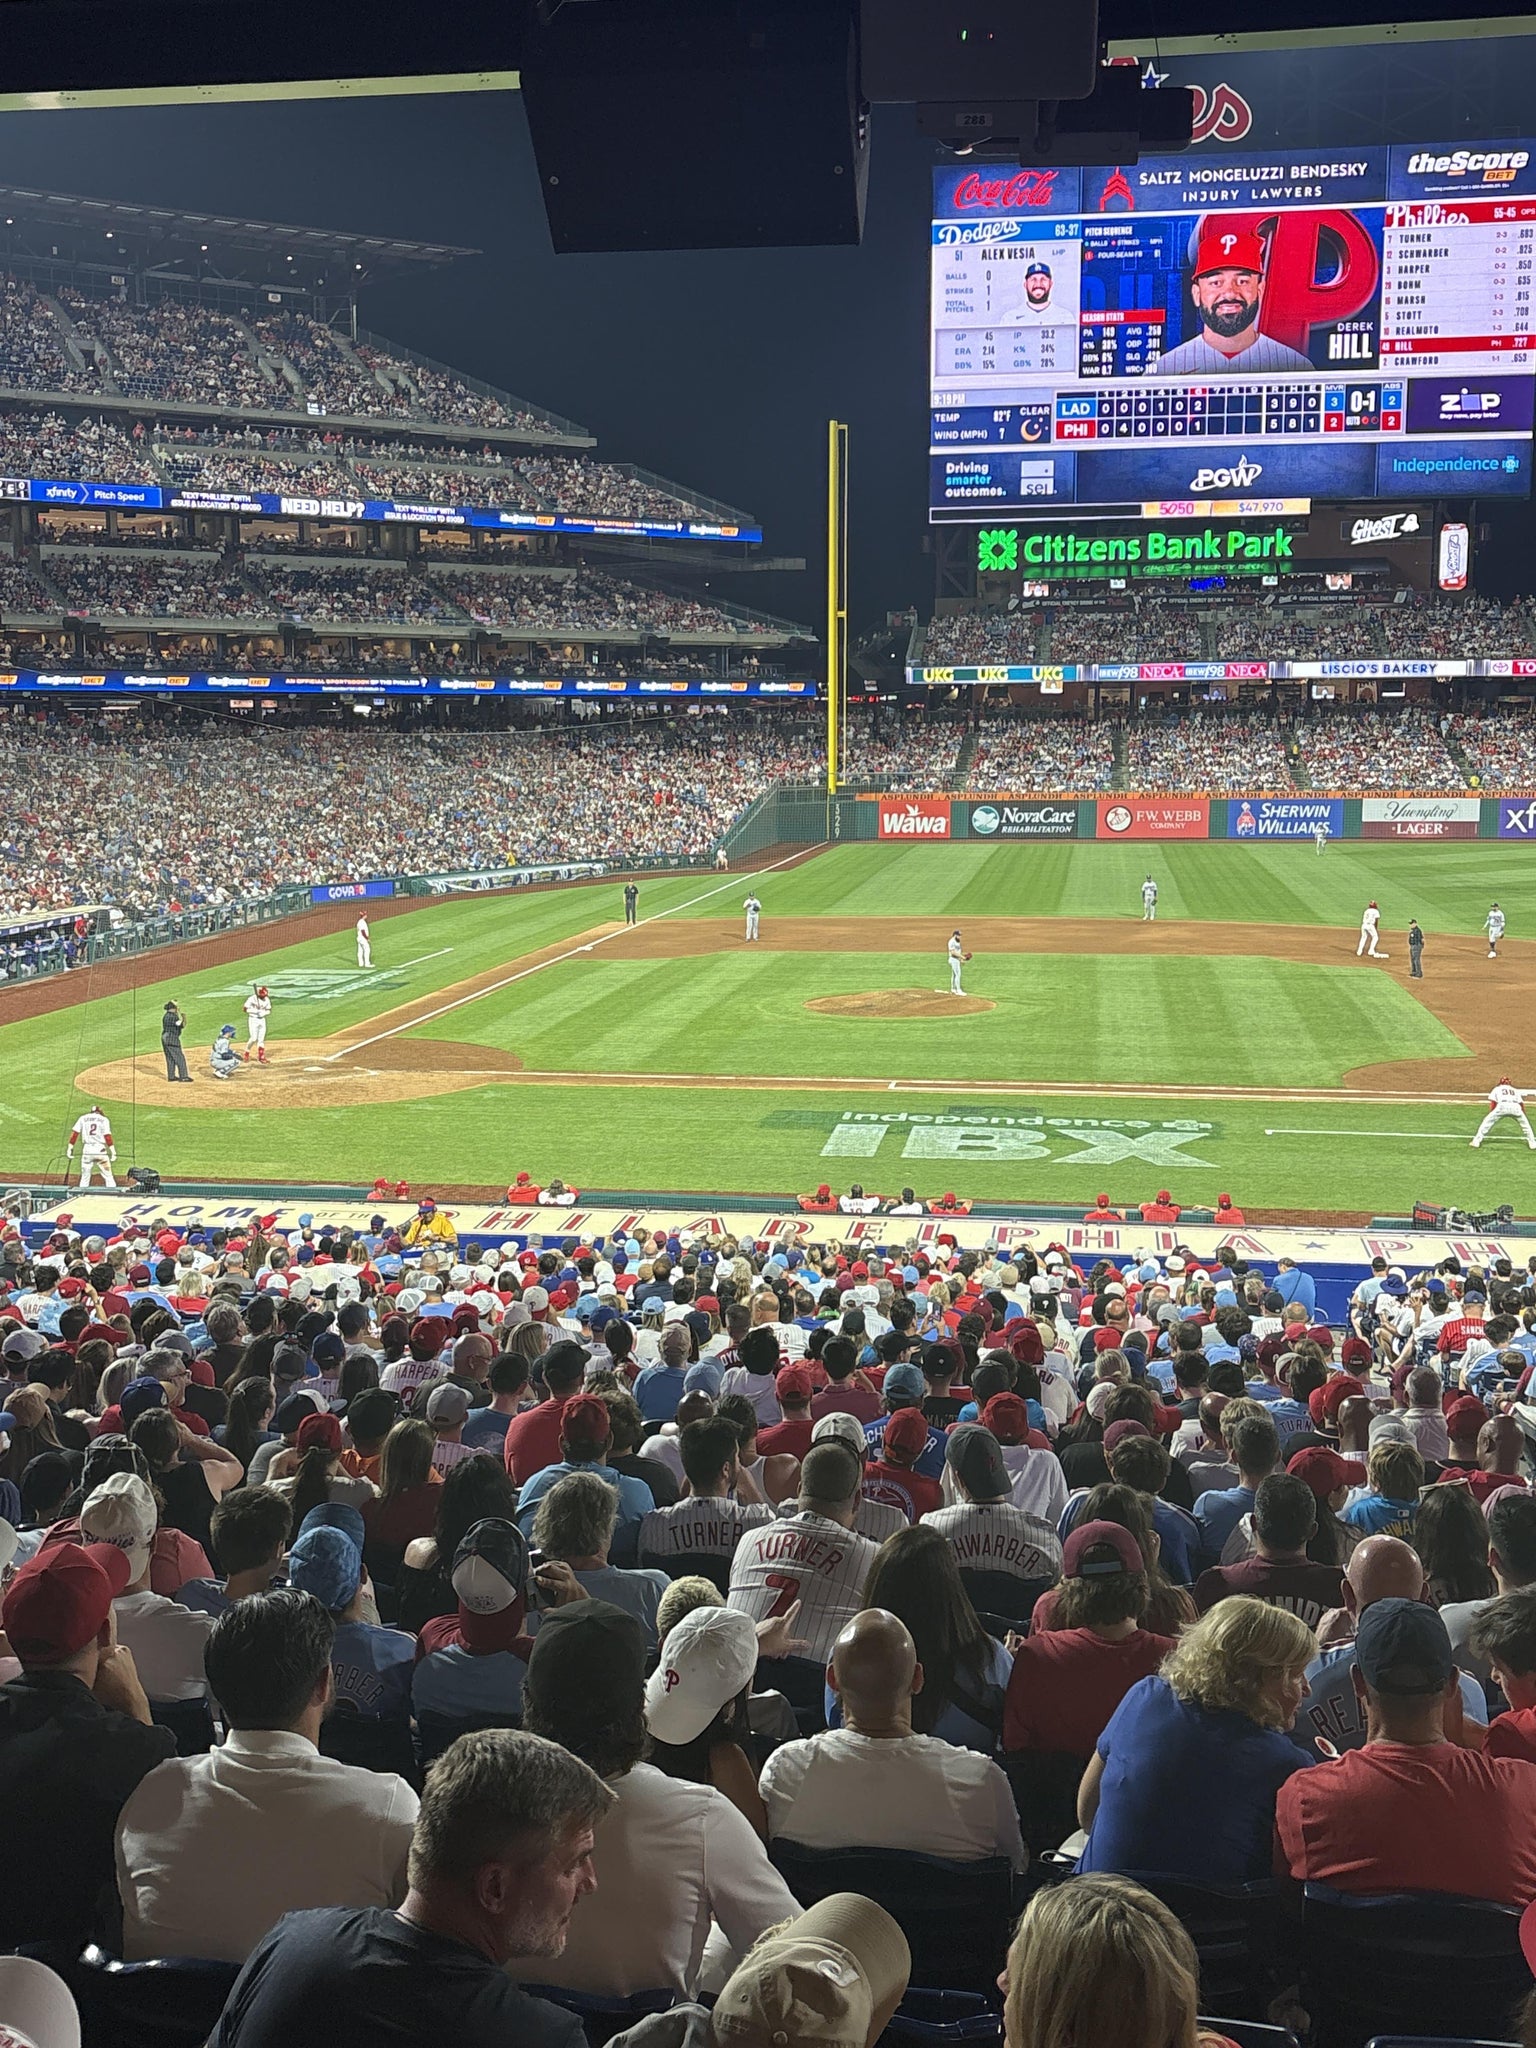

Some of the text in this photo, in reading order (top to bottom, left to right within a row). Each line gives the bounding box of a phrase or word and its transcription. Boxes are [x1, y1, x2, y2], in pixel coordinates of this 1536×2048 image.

[1407, 151, 1530, 174] theScore
[1139, 163, 1368, 185] SALTZ MONGELUZZI BENDESKY
[1486, 171, 1513, 180] BET
[1182, 186, 1323, 202] INJURY LAWYERS
[1386, 204, 1517, 229] Phillies 55-45
[938, 220, 1079, 245] Dodgers 63-37
[1400, 233, 1432, 243] TURNER
[955, 246, 1035, 261] 51 ALEX VESIA
[1398, 248, 1449, 259] SCHWARBER
[986, 270, 991, 281] 0
[1398, 264, 1430, 274] HARPER
[1397, 280, 1421, 290] BOHM
[1396, 295, 1426, 305] MARSH
[1396, 310, 1422, 320] STOTT
[1083, 327, 1142, 336] PA AVG
[1337, 321, 1374, 331] DEREK
[1396, 325, 1438, 335] REALMUTO
[955, 330, 1055, 342] GP 45 IP 33.2
[955, 345, 1026, 356] ERA 2.14 K%
[1328, 333, 1373, 359] HILL
[1394, 341, 1413, 351] HILL
[1394, 356, 1439, 366] CRAWFORD
[1082, 366, 1100, 375] WAR
[1061, 390, 1396, 416] LAD 0 0 0 1 0 2 3 9 0 3 0-1 2
[934, 406, 1050, 422] TEMP CLEAR
[1470, 412, 1482, 420] pay
[1063, 423, 1088, 436] PHI
[1101, 423, 1109, 432] 0
[1119, 423, 1128, 432] 4
[1138, 422, 1145, 432] 0
[1157, 422, 1164, 431] 0
[1175, 421, 1182, 431] 0
[1194, 421, 1200, 431] 1
[1270, 419, 1278, 428] 5
[1289, 418, 1296, 428] 8
[1309, 418, 1315, 428] 1
[1329, 417, 1337, 427] 2
[1387, 415, 1395, 426] 2
[934, 429, 987, 440] WIND (MPH)
[946, 461, 989, 474] Driving
[1393, 456, 1499, 475] Independence
[946, 474, 992, 486] smarter
[1197, 466, 1254, 489] PGW
[46, 486, 145, 503] xfinity Pitch Speed
[181, 491, 200, 499] TEXT
[945, 485, 1007, 498] outcomes.
[197, 500, 240, 510] LOCATION TO
[281, 497, 320, 515] NEED
[321, 500, 366, 519] HELP?
[1238, 501, 1284, 513] $47,970
[1350, 513, 1406, 545] GHOST
[1024, 527, 1293, 564] Citizens Bank Park
[923, 667, 954, 683] UKG
[977, 666, 1008, 682] UKG
[1031, 665, 1064, 682] UKG
[1143, 665, 1181, 679] NECA
[1229, 664, 1267, 678] NECA
[1321, 663, 1438, 675] LISCIO'S BAKERY
[1136, 810, 1202, 822] F.W. WEBB
[1259, 802, 1331, 818] SHERWIN
[1384, 800, 1459, 821] Yuengling
[882, 811, 947, 834] Wawa
[1001, 825, 1073, 834] REHABILITATION
[1150, 822, 1186, 830] COMPANY
[1396, 822, 1443, 835] LAGER
[328, 885, 355, 899] GOYA
[842, 1111, 1152, 1129] Independence
[89, 1123, 97, 1136] 2
[820, 1123, 1220, 1168] IBX
[121, 1203, 297, 1219] HOME
[1460, 1325, 1486, 1336] SANCH
[394, 1364, 440, 1381] HARPER
[1280, 1419, 1312, 1434] TURN
[754, 1532, 845, 1576] TURNER
[763, 1572, 802, 1619] 7
[664, 1667, 680, 1694] P
